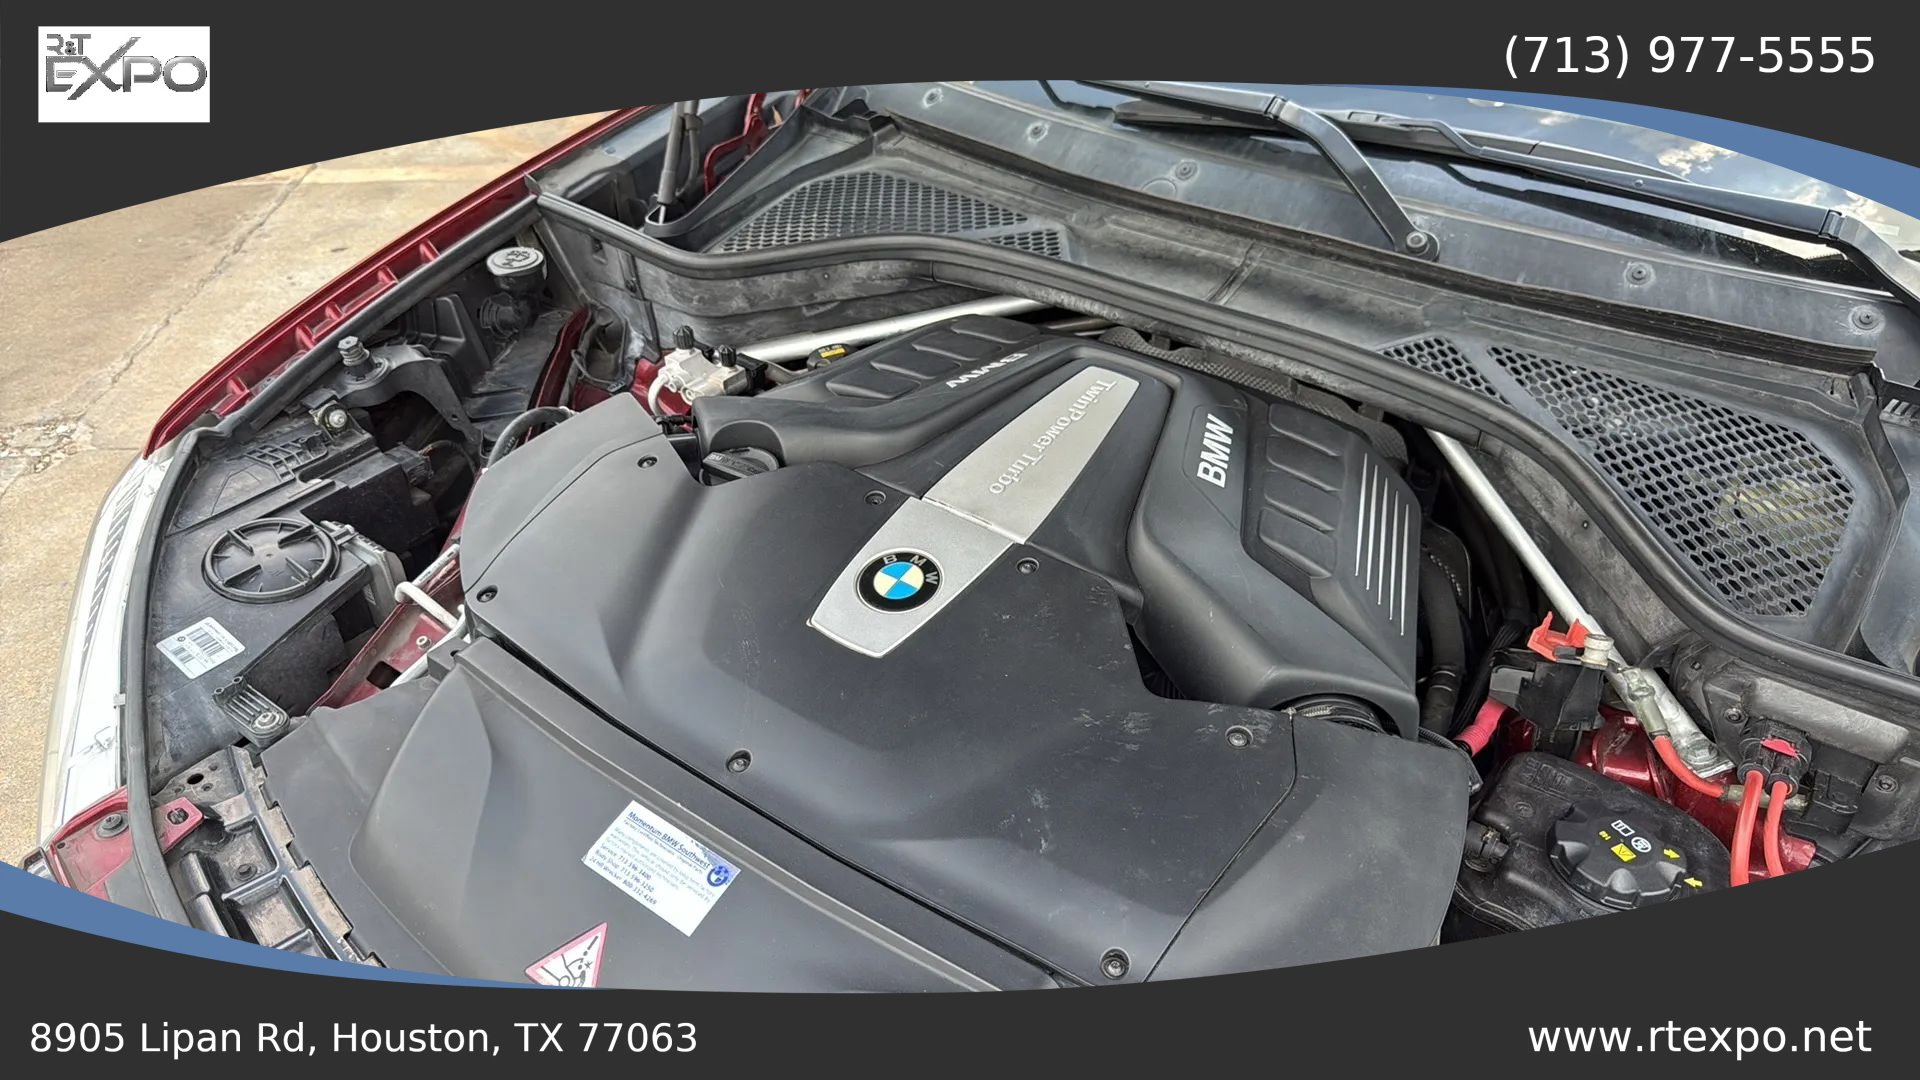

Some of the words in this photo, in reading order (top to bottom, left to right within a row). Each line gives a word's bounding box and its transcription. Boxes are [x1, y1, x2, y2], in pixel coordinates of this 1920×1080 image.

[946, 352, 1028, 388] BMW
[1033, 378, 1117, 453] TwinPower
[988, 452, 1043, 495] Turbo
[1196, 412, 1234, 489] BMW
[882, 554, 939, 585] BMW
[627, 810, 663, 836] Momentum
[660, 832, 680, 848] BMW
[676, 843, 711, 869] Southwest
